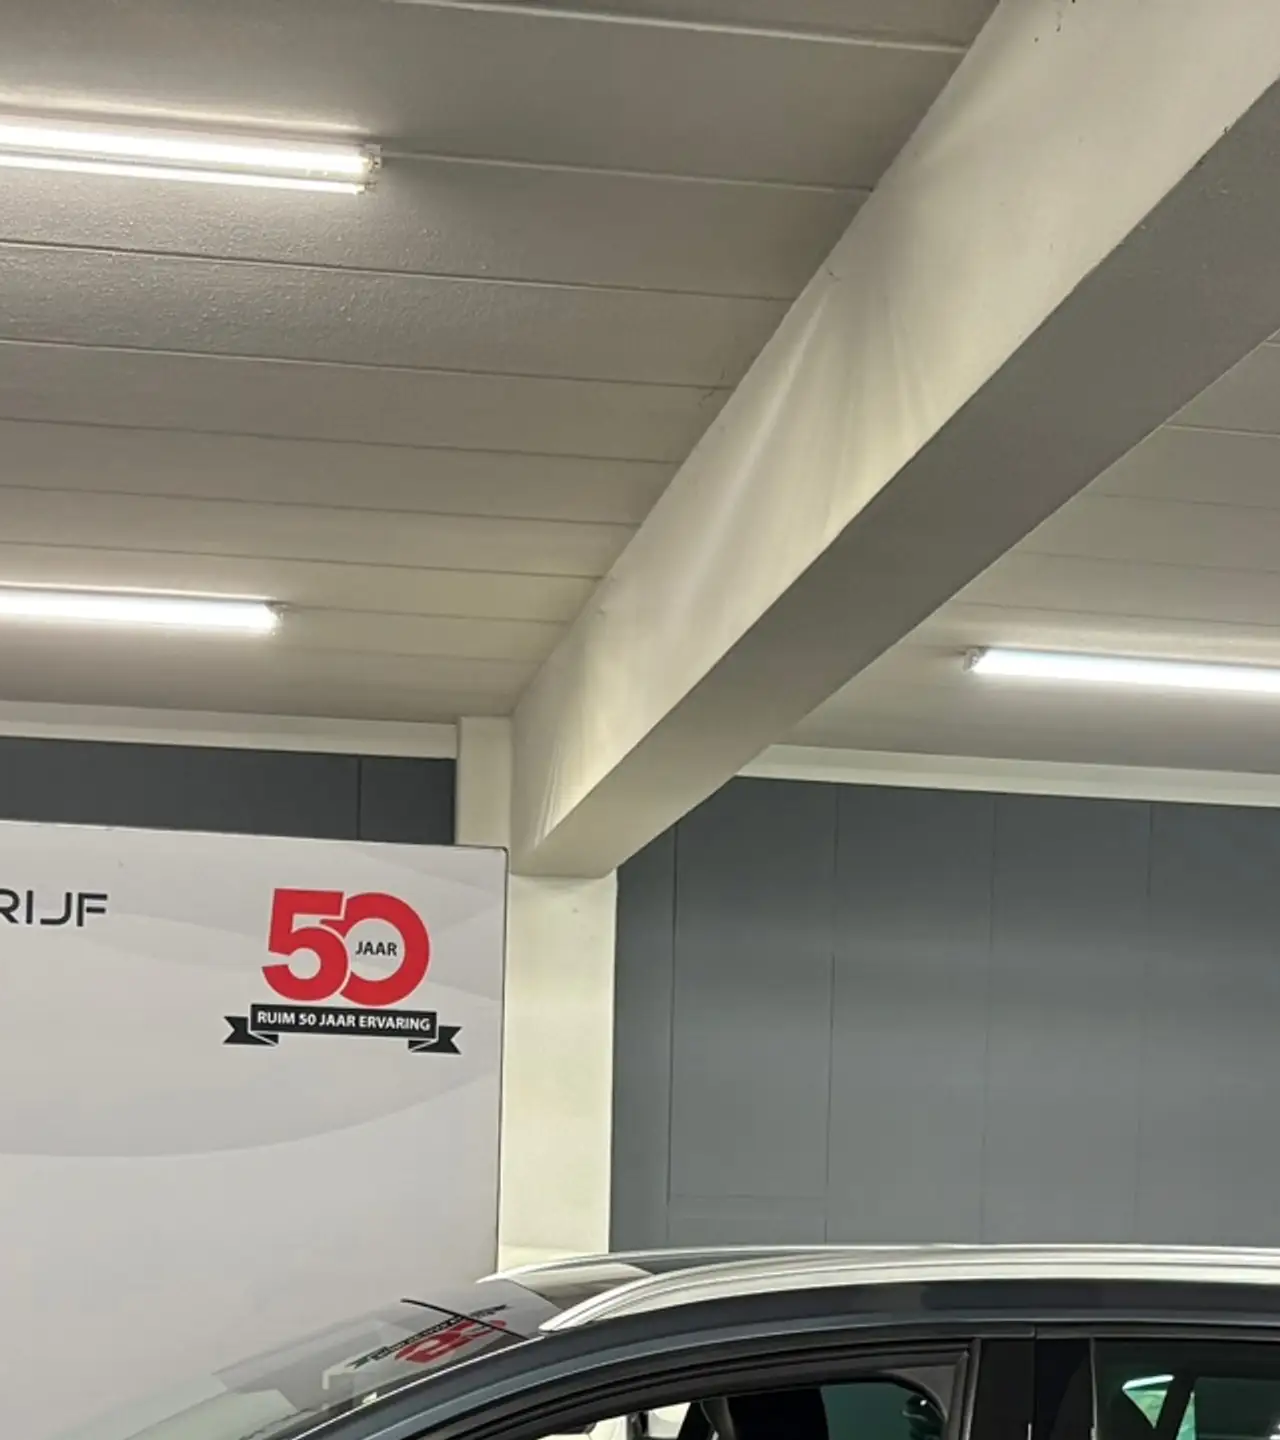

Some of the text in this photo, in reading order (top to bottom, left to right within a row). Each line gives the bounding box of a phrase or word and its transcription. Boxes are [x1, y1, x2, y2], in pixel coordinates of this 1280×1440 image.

[261, 887, 431, 1008] 50
[355, 941, 398, 956] JAAR
[257, 1010, 431, 1032] RUIM 50 JAAR ERVARING
